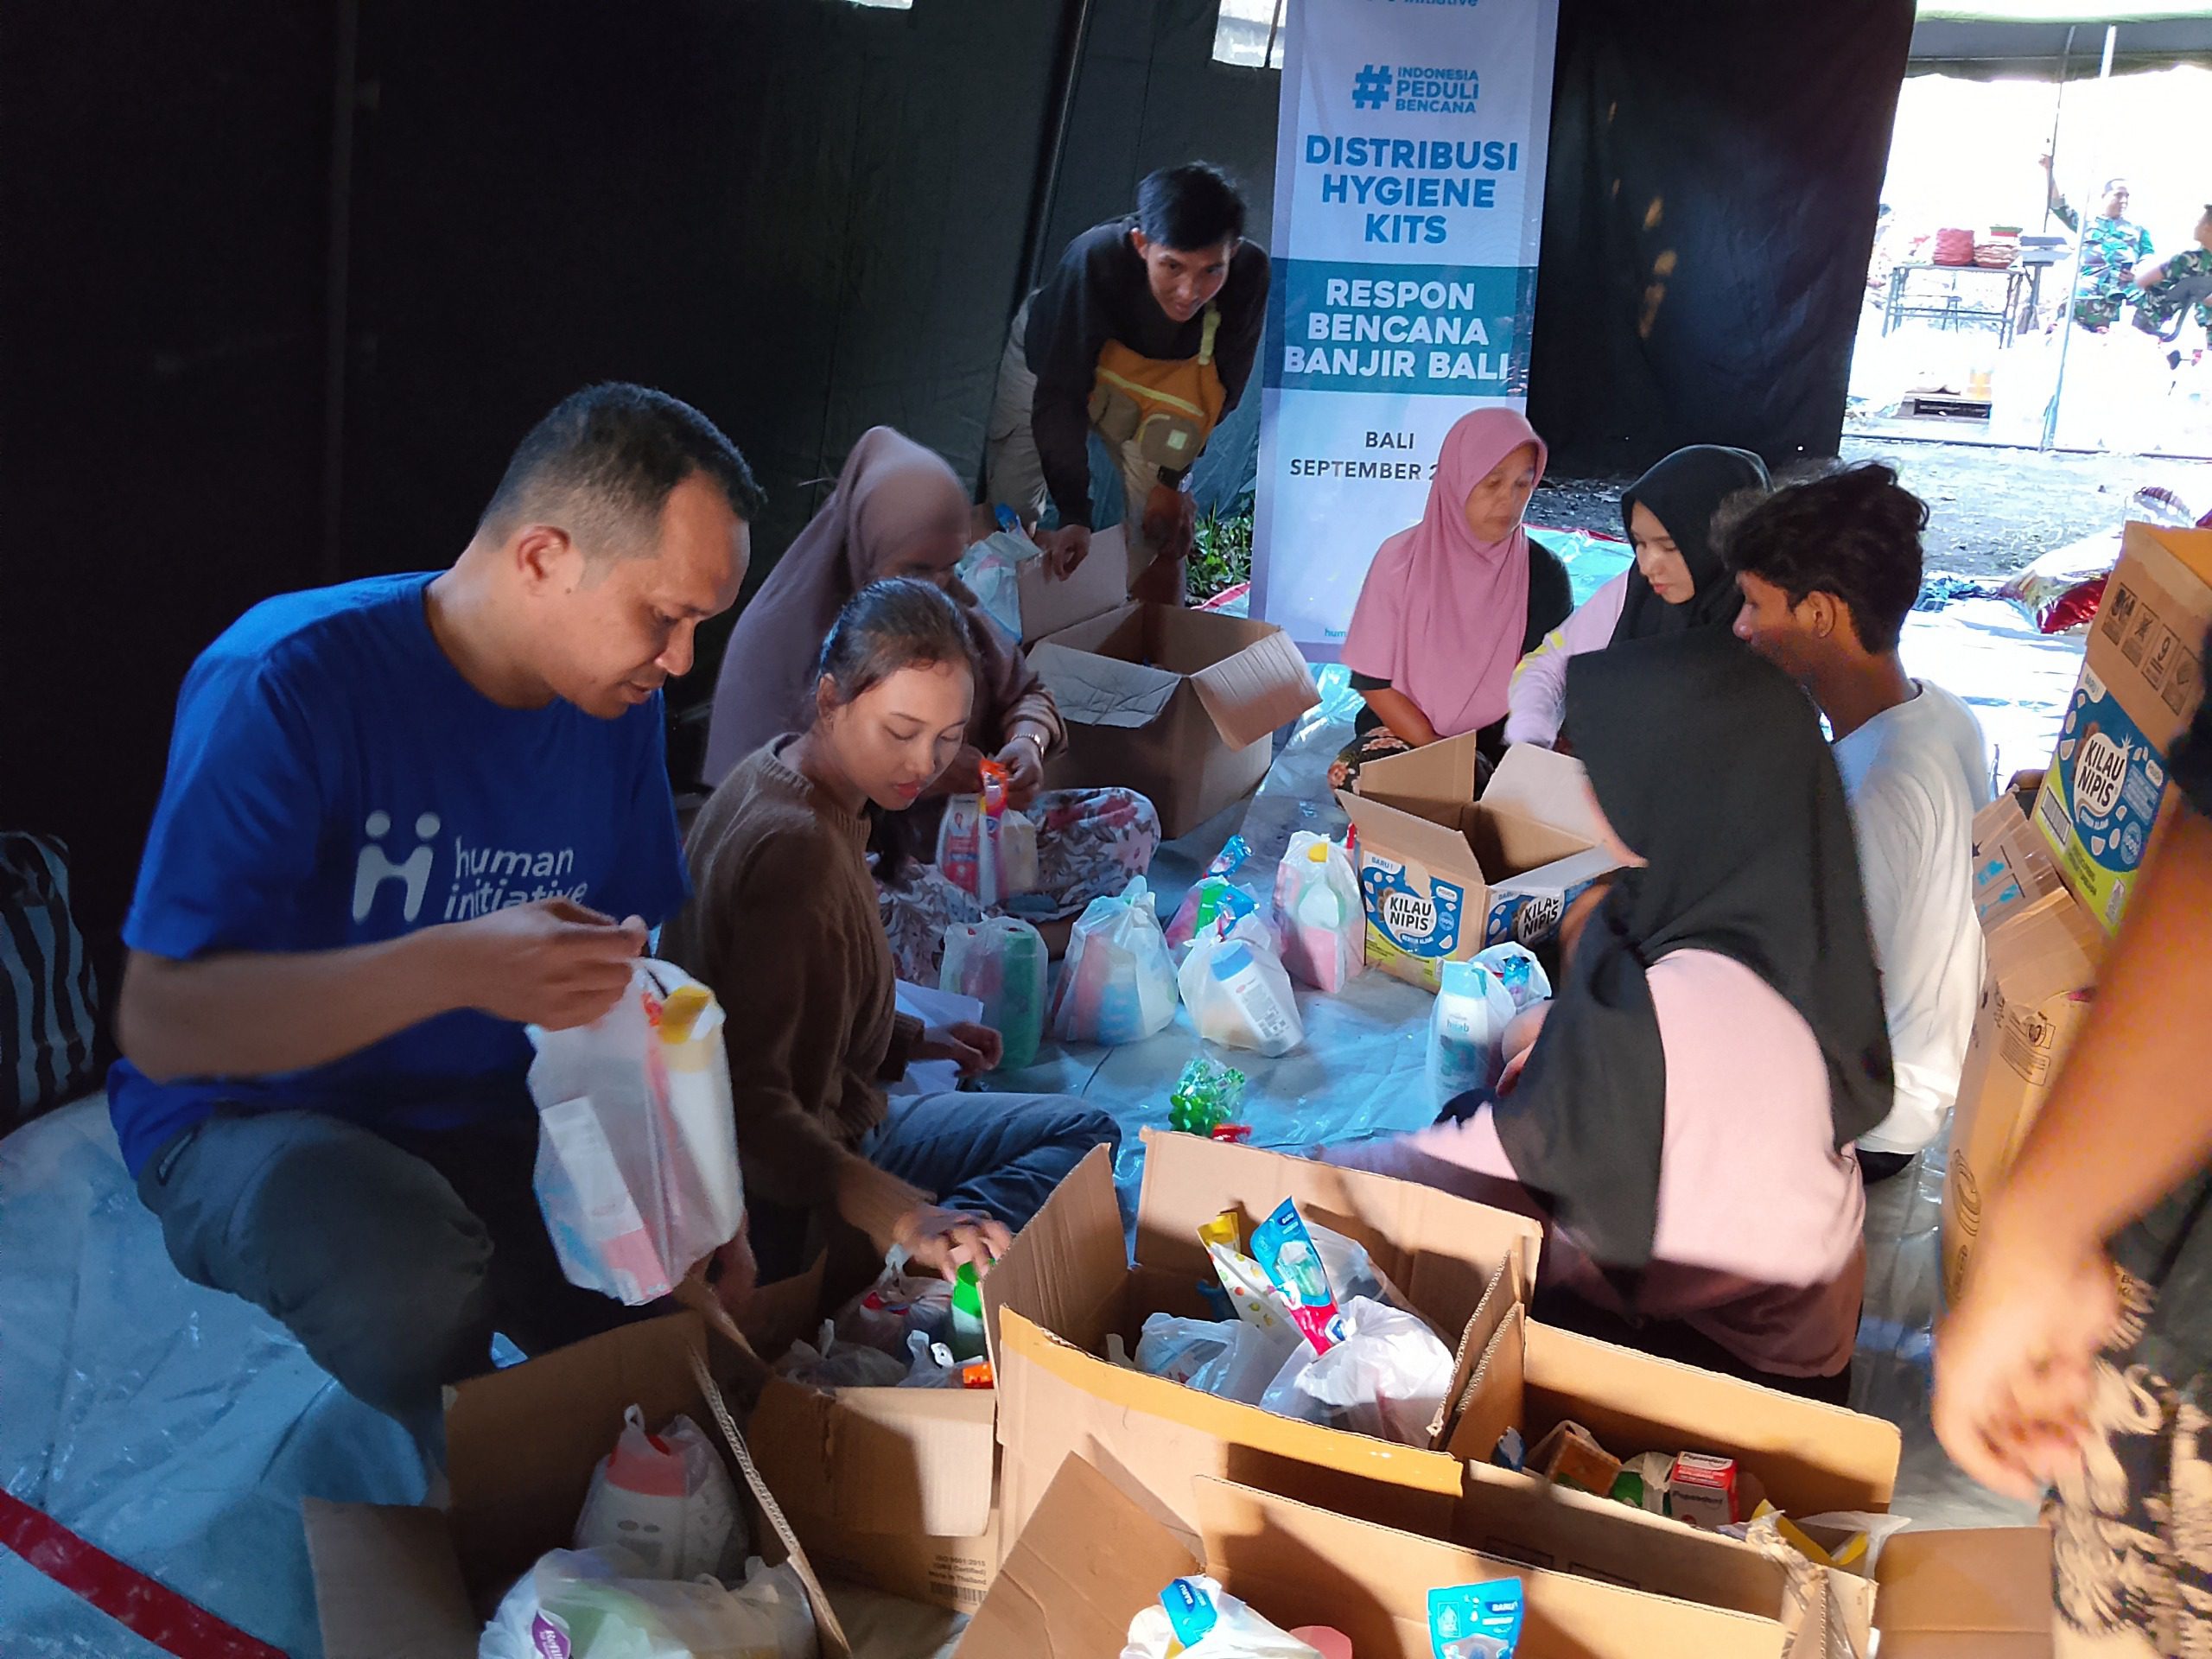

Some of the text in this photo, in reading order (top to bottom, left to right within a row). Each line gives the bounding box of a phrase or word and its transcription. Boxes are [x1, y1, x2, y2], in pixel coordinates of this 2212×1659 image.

[1397, 67, 1478, 81] INDONESIA
[1395, 80, 1478, 100] PEDULI
[1395, 99, 1477, 113] BENCANA
[1305, 134, 1518, 171] DISTRIBUSI
[1321, 174, 1497, 208] HYGIENE
[1364, 213, 1447, 244] KITS
[1325, 278, 1475, 310] RESPON
[1307, 312, 1490, 346] BENCANA
[1283, 346, 1510, 380] BANJIR BALI
[1365, 431, 1414, 449] BALI
[1289, 458, 1422, 480] SEPTEMBER
[1325, 627, 1347, 638] hum
[2084, 739, 2125, 781] KILAU
[2078, 766, 2114, 807] NIPIS
[454, 836, 574, 879] human
[1389, 897, 1432, 917] KILAU
[1389, 912, 1429, 931] NIPIS
[1523, 906, 1558, 938] NIPIS
